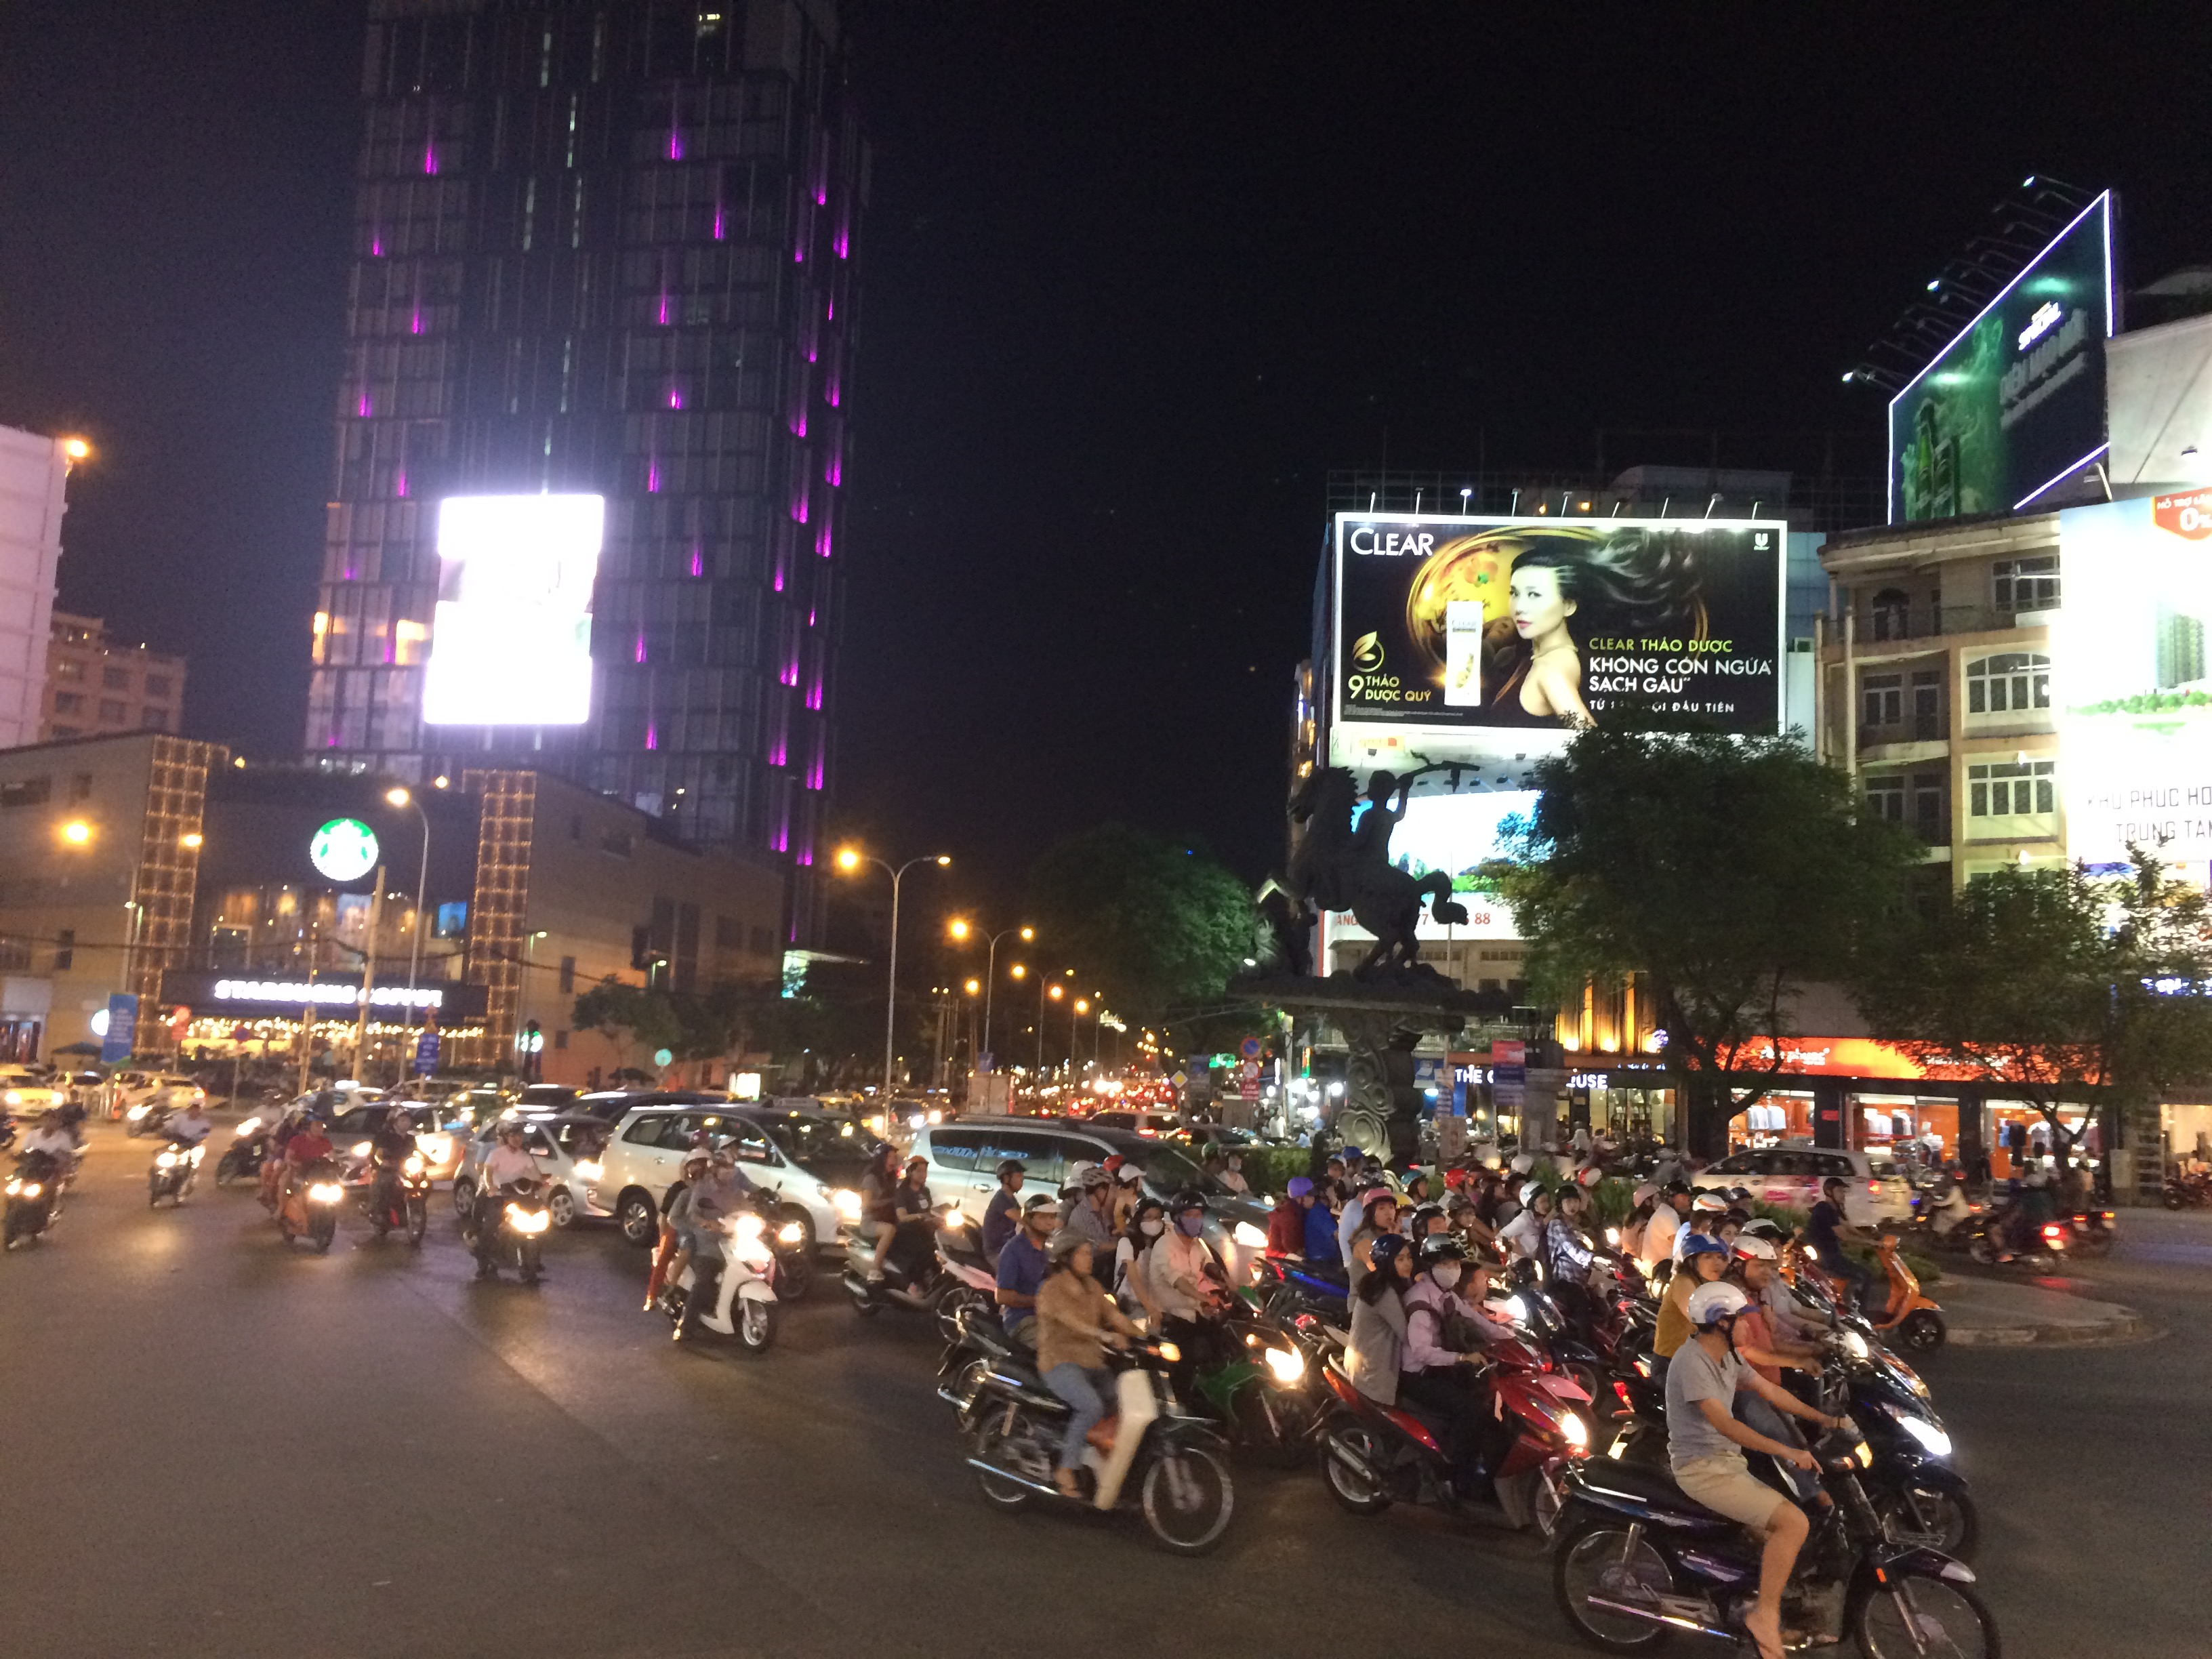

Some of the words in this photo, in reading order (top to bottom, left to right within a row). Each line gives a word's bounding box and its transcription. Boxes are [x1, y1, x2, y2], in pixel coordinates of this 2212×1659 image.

[1351, 527, 1434, 556] CLEAR
[1589, 638, 1634, 651] CLEAR
[1641, 636, 1683, 652] THẢO
[1689, 640, 1733, 654] DƯỢC
[1589, 656, 1659, 674] KHÔNG
[1348, 674, 1364, 699] 9
[1365, 673, 1399, 687] THẢO
[1589, 676, 1637, 693] SẠCH
[1365, 689, 1401, 703] DƯỢC
[1405, 689, 1431, 701] QUÝ
[2116, 821, 2175, 842] TRUNG
[1455, 1069, 1483, 1084] THE
